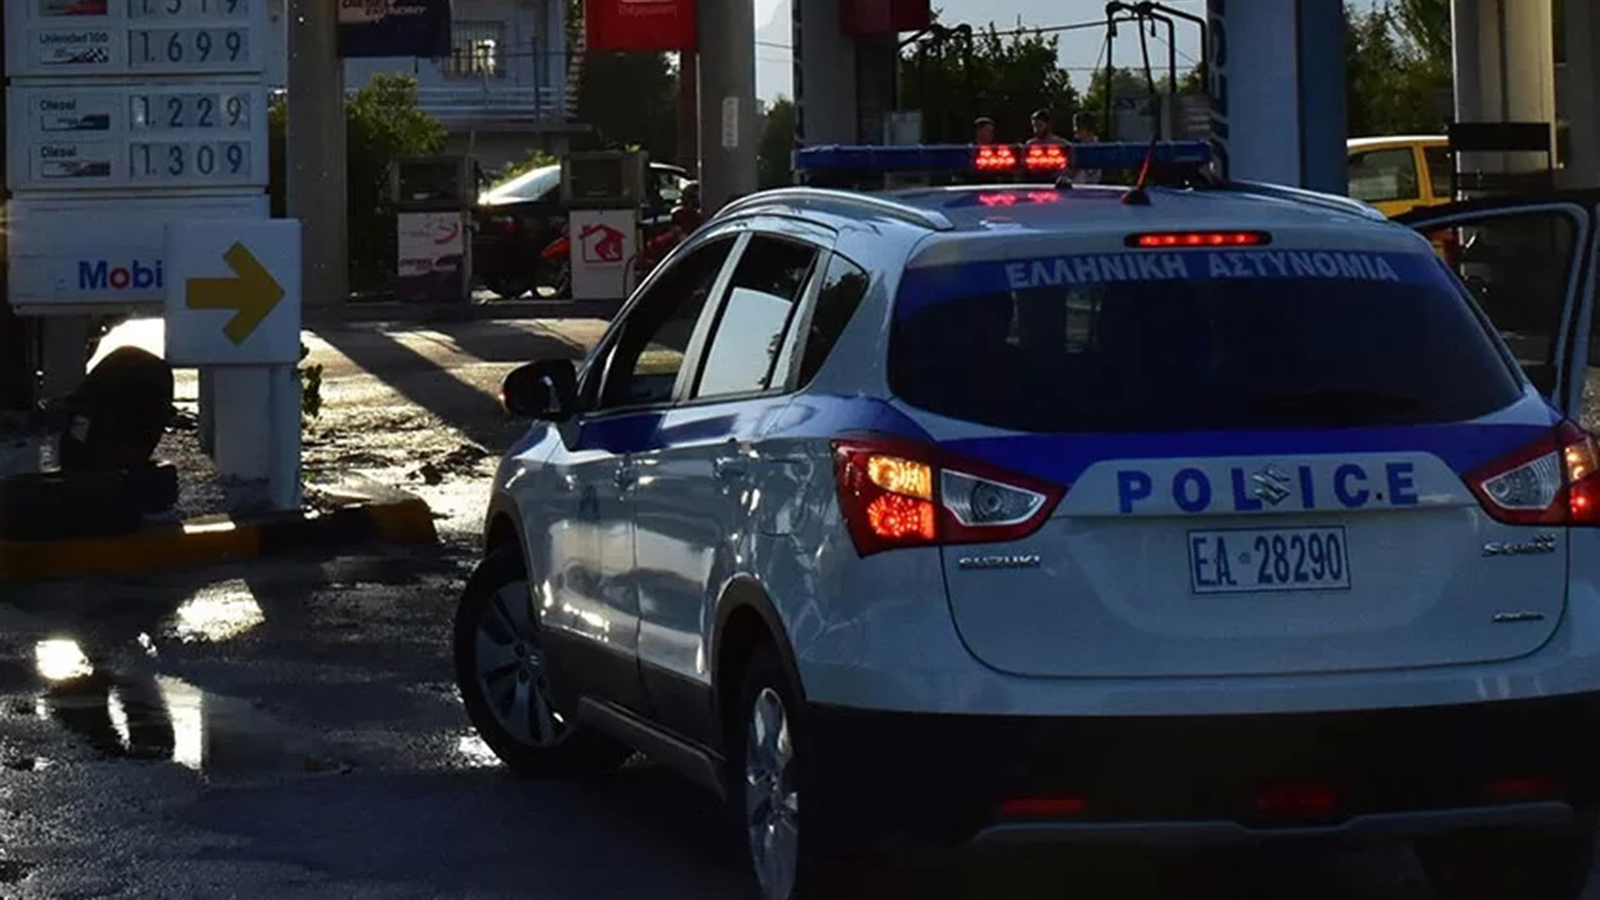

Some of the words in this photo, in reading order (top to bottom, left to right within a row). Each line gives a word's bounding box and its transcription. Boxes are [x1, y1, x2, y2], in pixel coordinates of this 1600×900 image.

[89, 31, 108, 43] 100
[139, 31, 241, 63] 1.699
[141, 97, 241, 129] 1.229
[142, 145, 243, 176] 1.309
[78, 260, 164, 290] Mobi
[1005, 253, 1189, 289] ΕΛΛΗΝΙΚΗ
[1208, 250, 1400, 282] ΑΣΤΥΝΟΜΙΑ
[1116, 462, 1419, 514] POLICE
[1254, 532, 1343, 585] 28290
